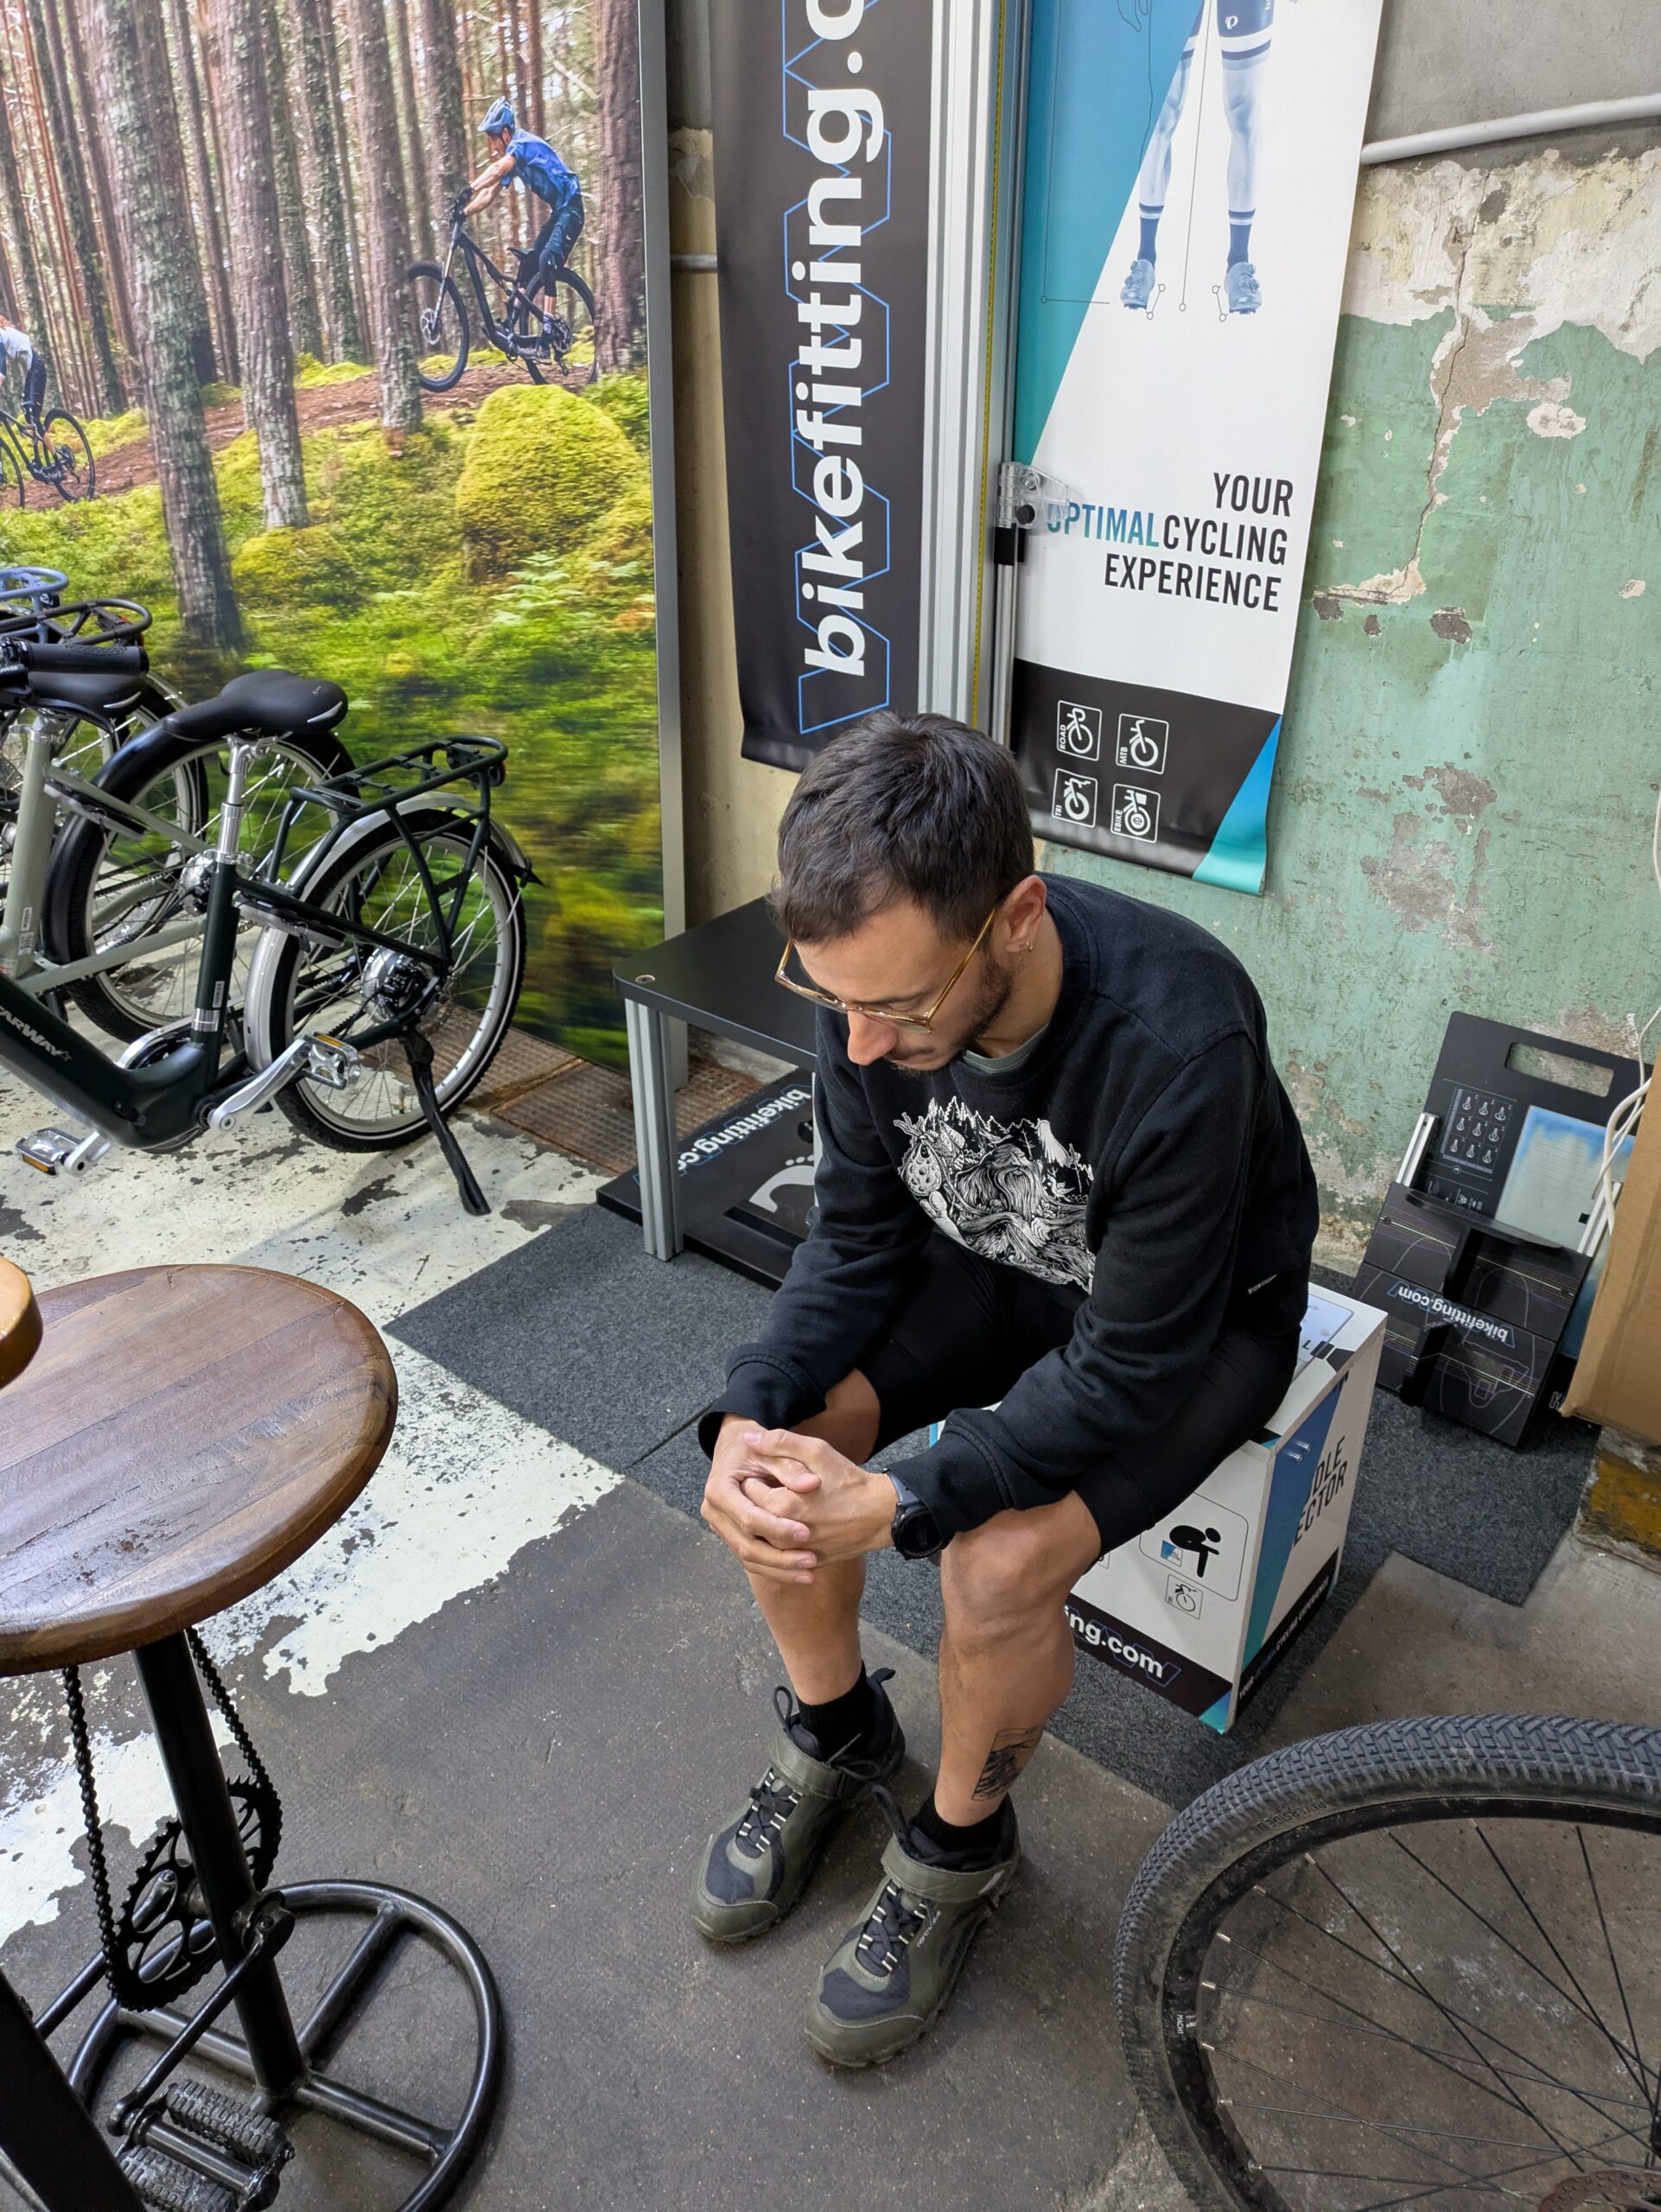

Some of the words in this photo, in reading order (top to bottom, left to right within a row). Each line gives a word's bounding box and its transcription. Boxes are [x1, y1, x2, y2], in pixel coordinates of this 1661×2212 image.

[1213, 473, 1294, 517] YOUR
[1047, 501, 1160, 548] OPTIMAL
[1163, 514, 1288, 565] CYCLING
[1104, 553, 1282, 613] EXPERIENCE
[1119, 747, 1129, 765] MTB
[1114, 810, 1123, 832] EBIKE
[1398, 1286, 1509, 1343] bikefitting.com
